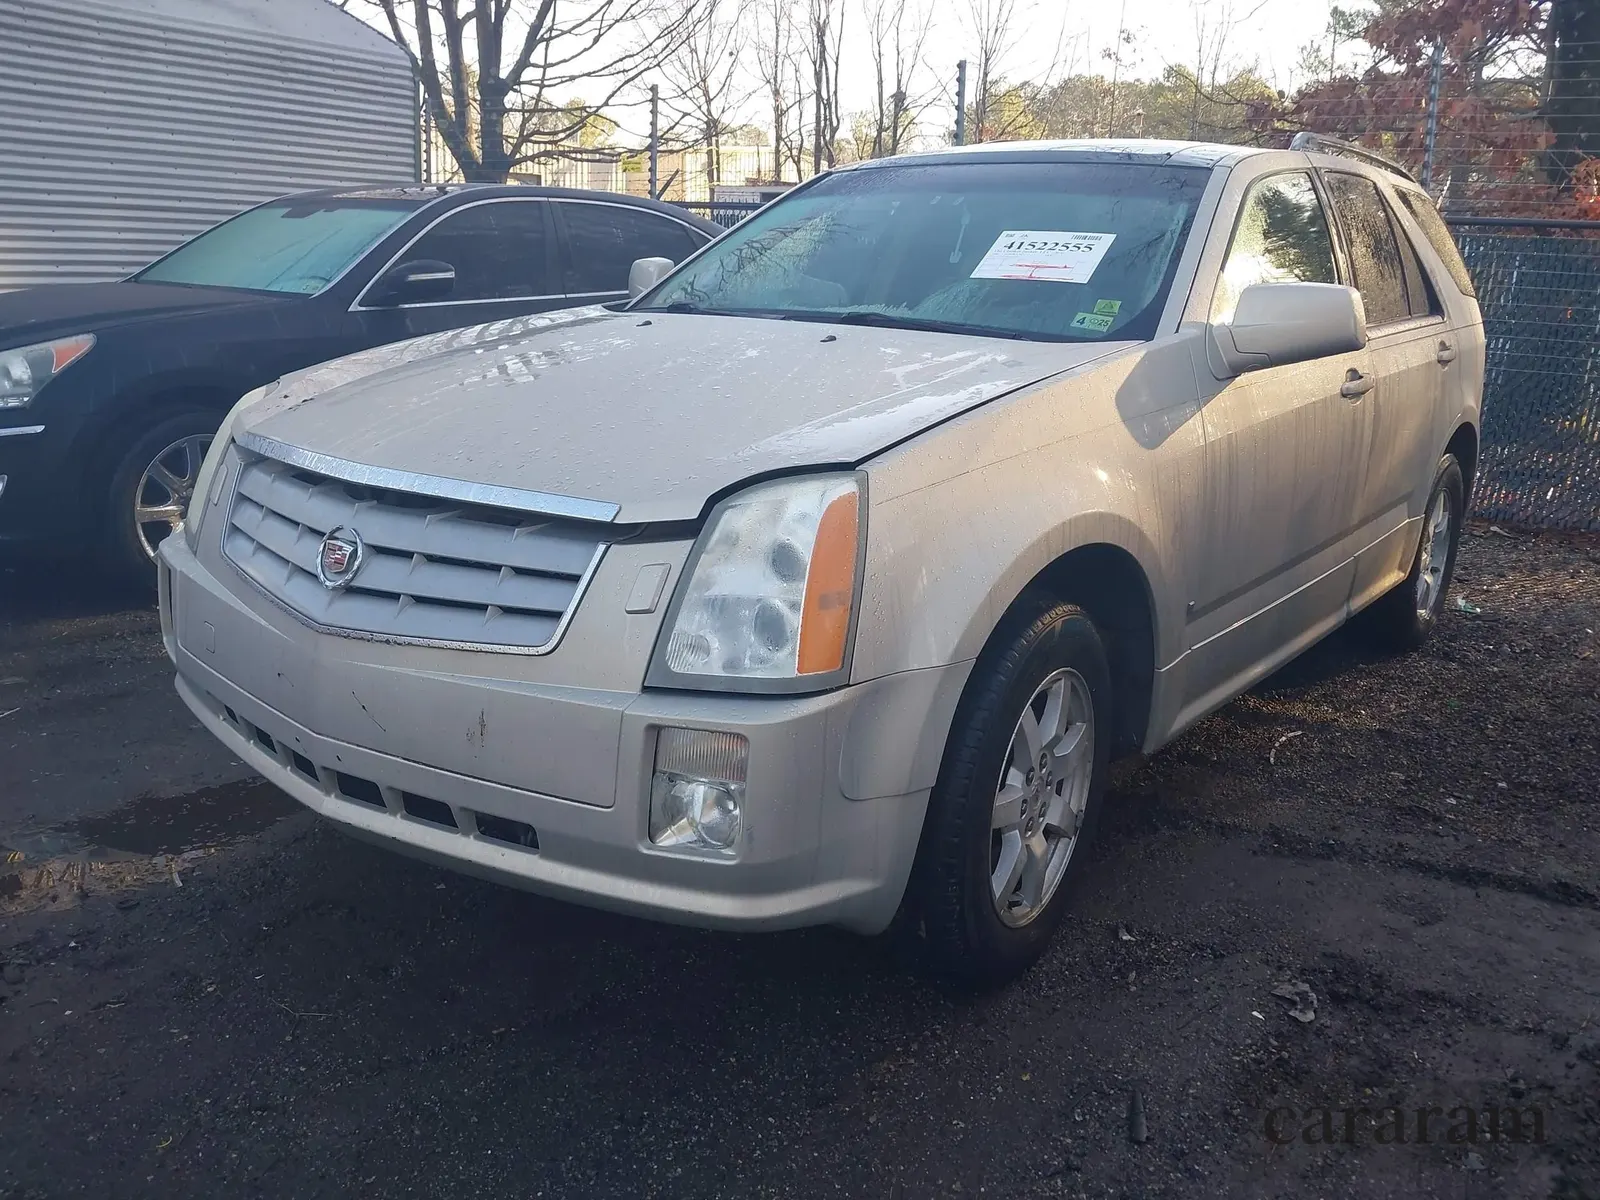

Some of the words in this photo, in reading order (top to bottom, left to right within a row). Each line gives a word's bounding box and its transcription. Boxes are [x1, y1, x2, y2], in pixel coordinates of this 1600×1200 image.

[1003, 240, 1096, 253] 41522555
[1075, 316, 1087, 326] 4
[1097, 319, 1110, 327] 25
